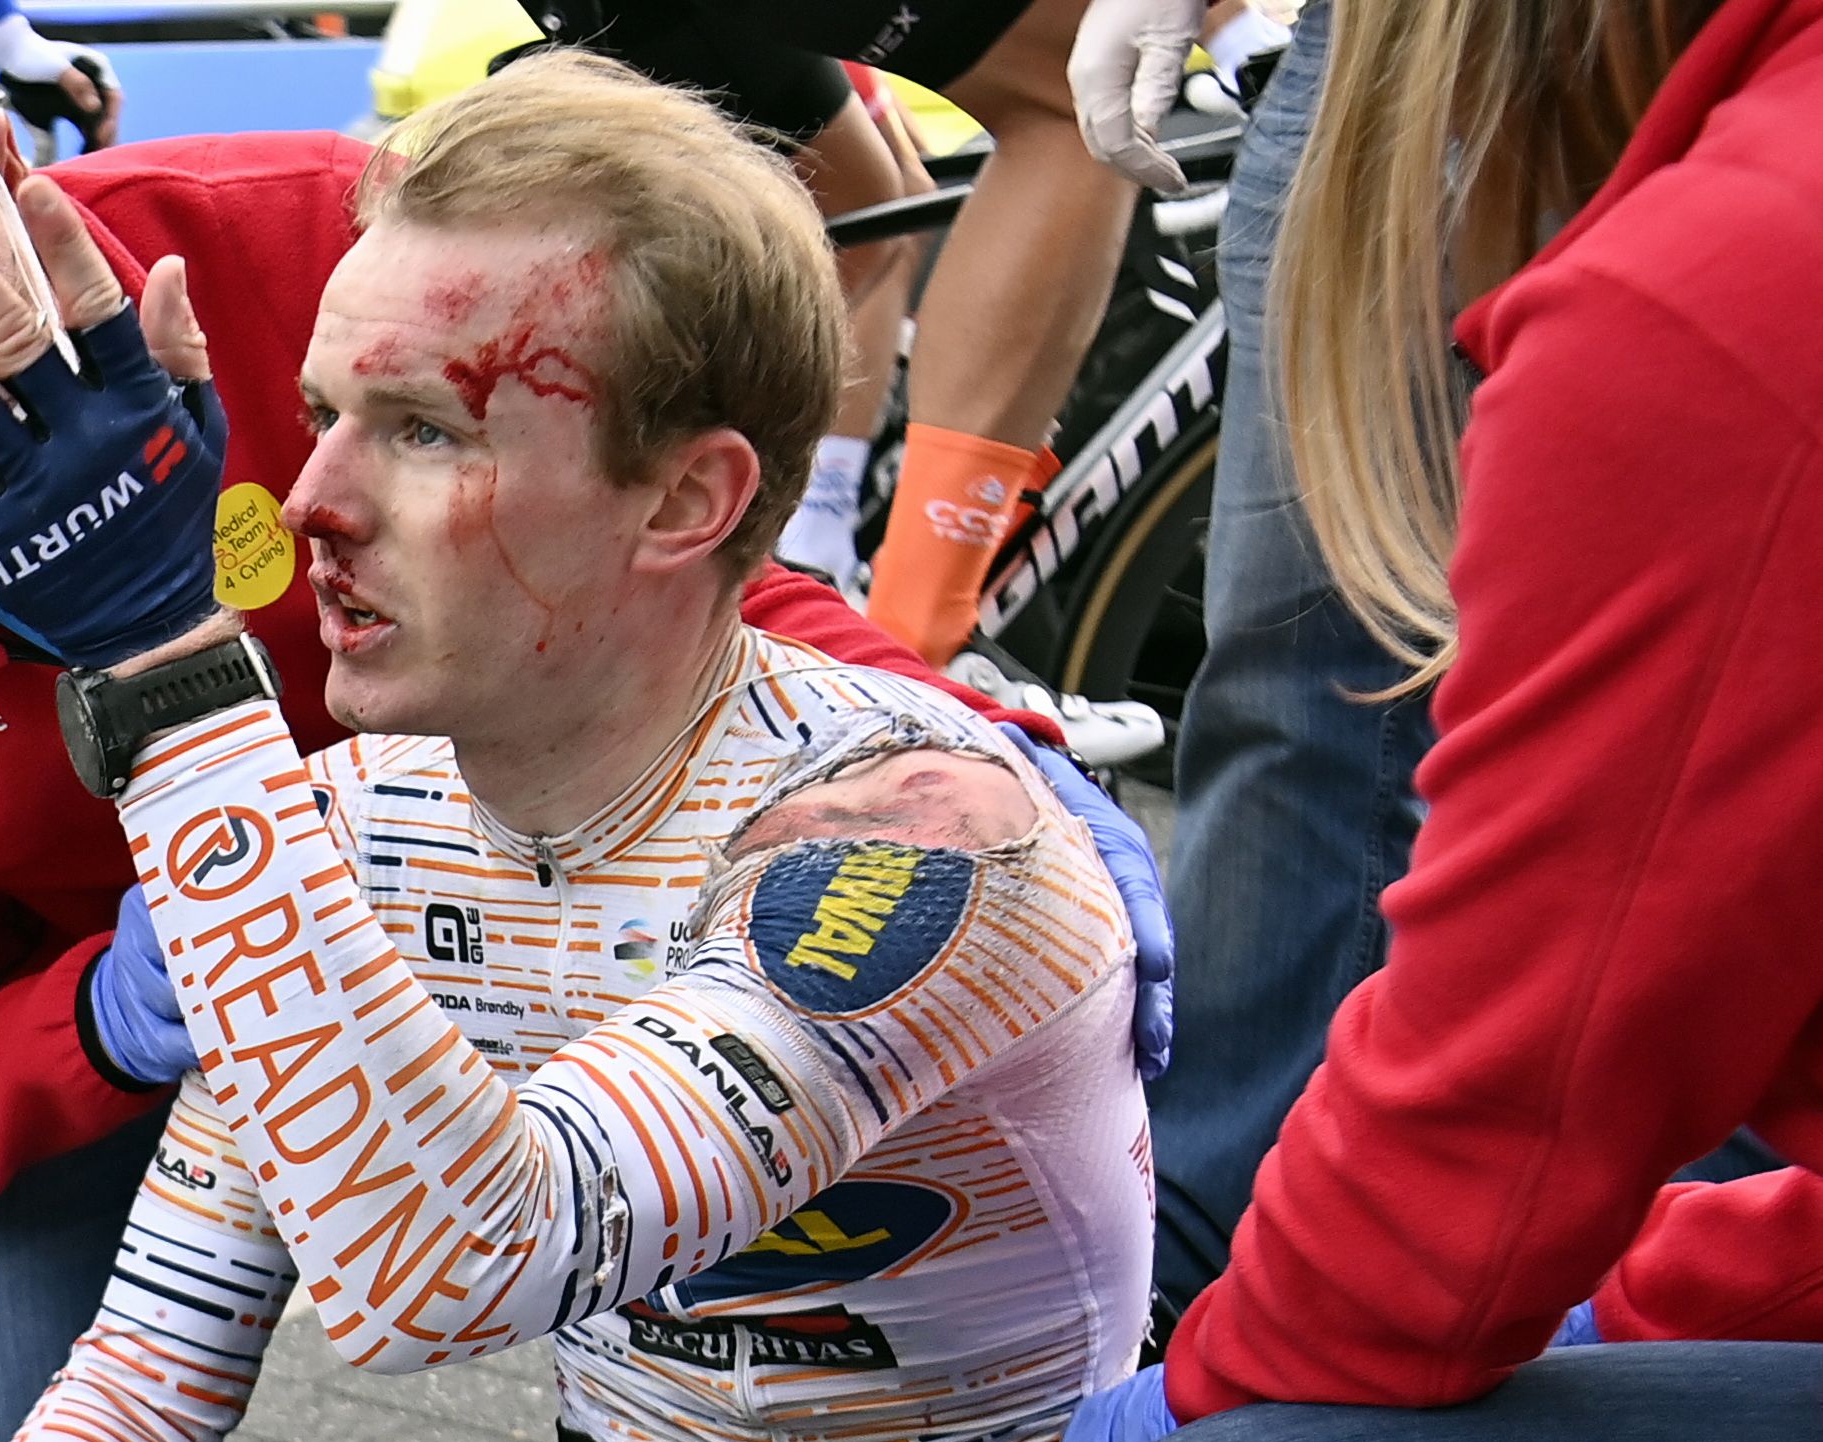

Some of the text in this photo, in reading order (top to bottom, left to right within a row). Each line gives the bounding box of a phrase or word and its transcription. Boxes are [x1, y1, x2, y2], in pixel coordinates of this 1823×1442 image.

[230, 521, 266, 553] Team
[225, 538, 285, 590] 4 Cycling
[192, 892, 537, 1342] READYNEZ
